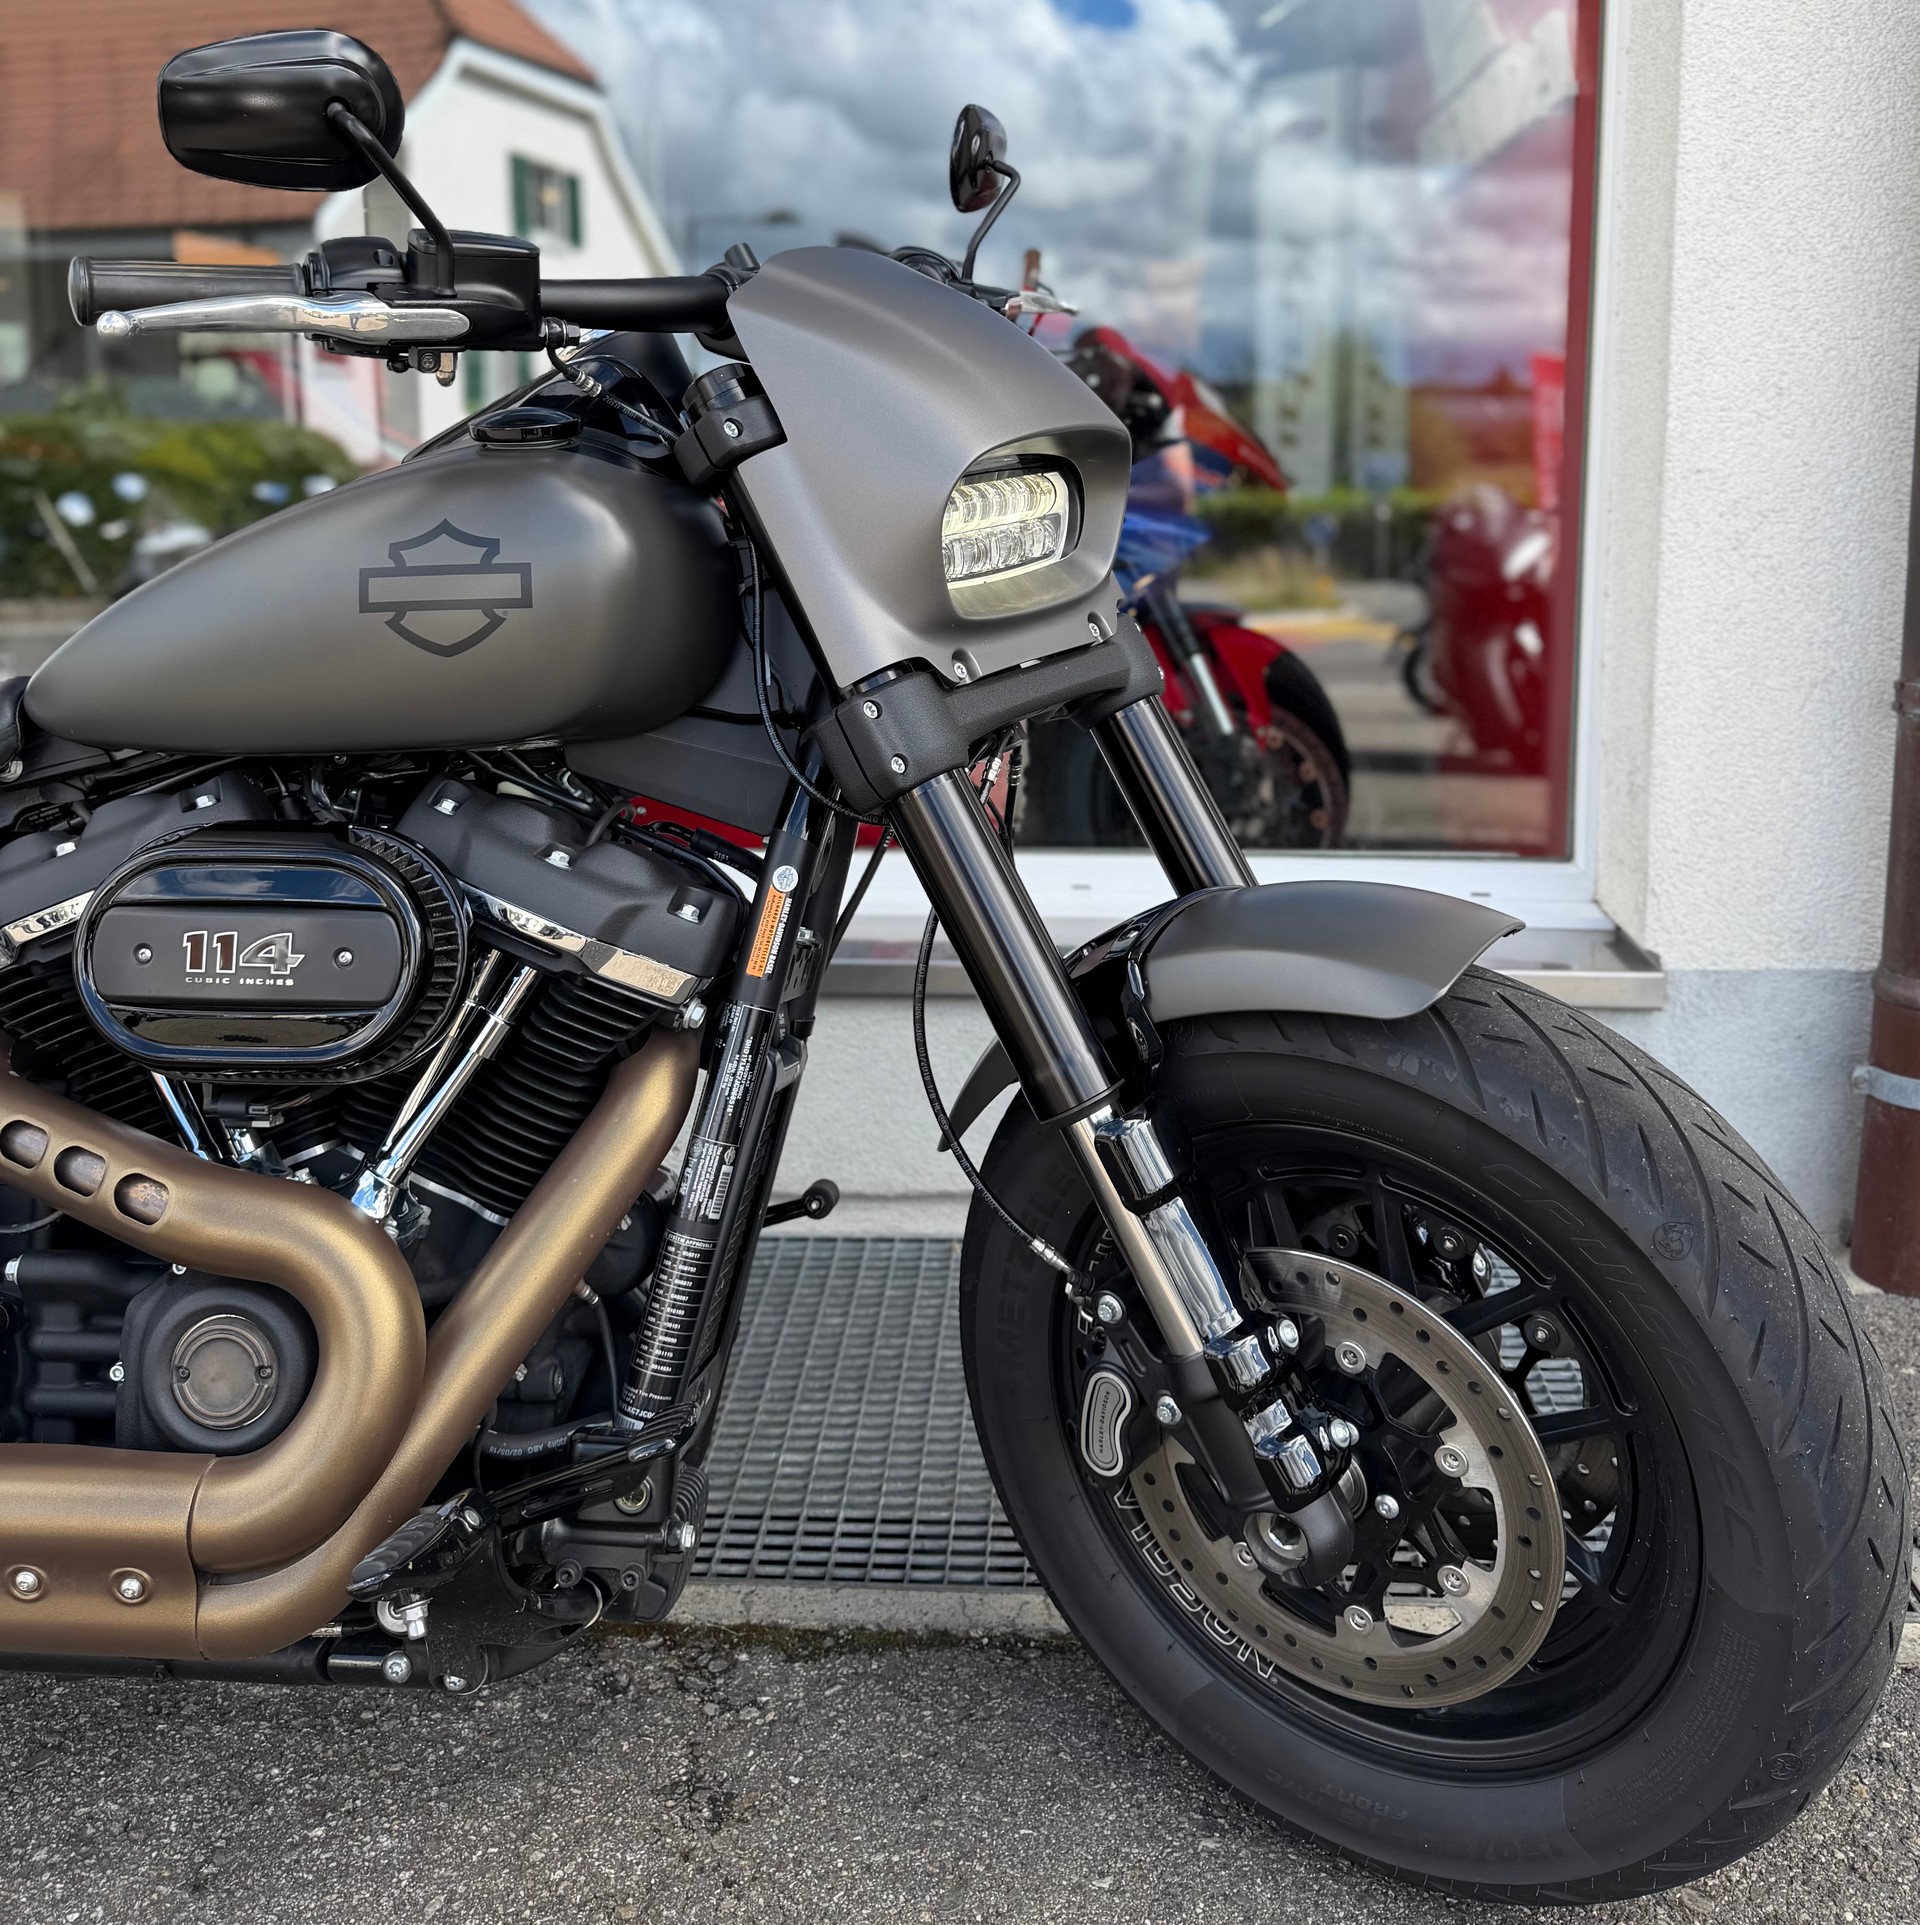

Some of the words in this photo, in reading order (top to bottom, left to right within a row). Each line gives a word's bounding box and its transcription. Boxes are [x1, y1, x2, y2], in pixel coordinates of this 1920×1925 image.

[182, 930, 305, 975] 114
[765, 955, 777, 974] BASEL
[185, 976, 230, 985] CUBIC
[239, 977, 294, 986] INCHES
[1319, 1781, 1408, 1820] FRONT
